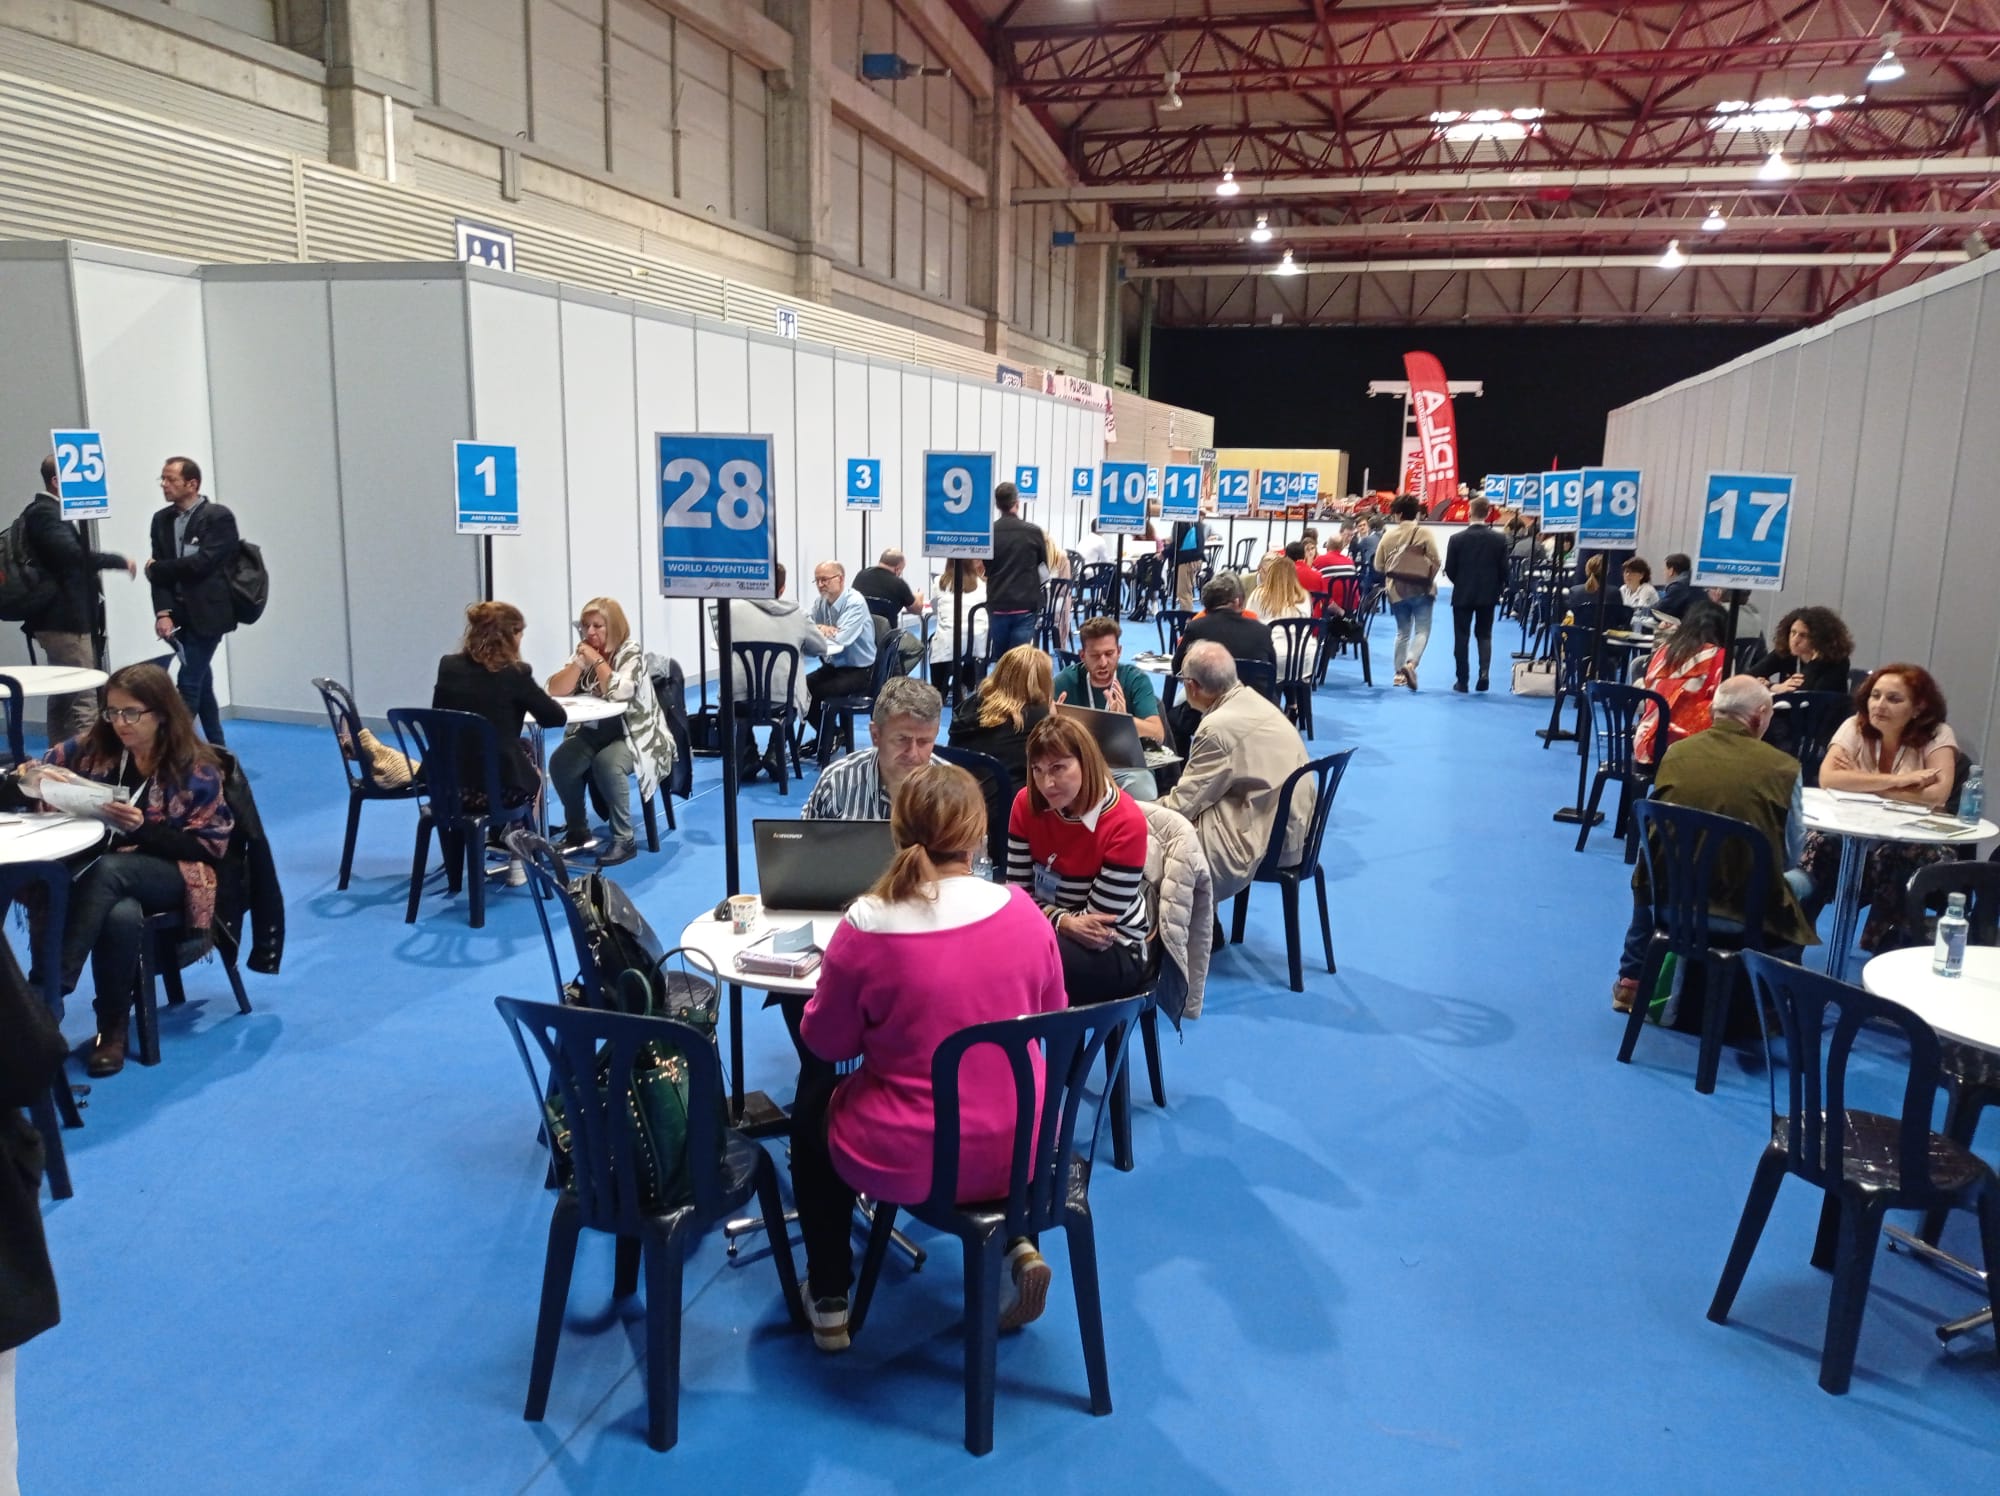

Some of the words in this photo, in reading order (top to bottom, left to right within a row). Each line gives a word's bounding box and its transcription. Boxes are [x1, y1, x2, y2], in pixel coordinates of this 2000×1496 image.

[58, 443, 104, 482] 25
[475, 455, 497, 497] 1
[855, 464, 872, 490] 3
[1020, 470, 1033, 488] 5
[1077, 470, 1089, 487] 6
[1101, 470, 1146, 504] 10
[1165, 472, 1198, 499] 11
[1220, 475, 1249, 496] 12
[1262, 475, 1287, 495] 13
[1288, 475, 1301, 493] 4
[1486, 479, 1505, 493] 24
[662, 457, 766, 531] 28
[942, 466, 973, 515] 9
[1523, 480, 1539, 499] 2
[1545, 480, 1580, 508] 19
[1583, 480, 1637, 516] 18
[1708, 490, 1788, 542] 17
[668, 563, 703, 573] WORLD
[705, 564, 766, 575] ADVENTURES
[1737, 565, 1762, 573] SOLAR
